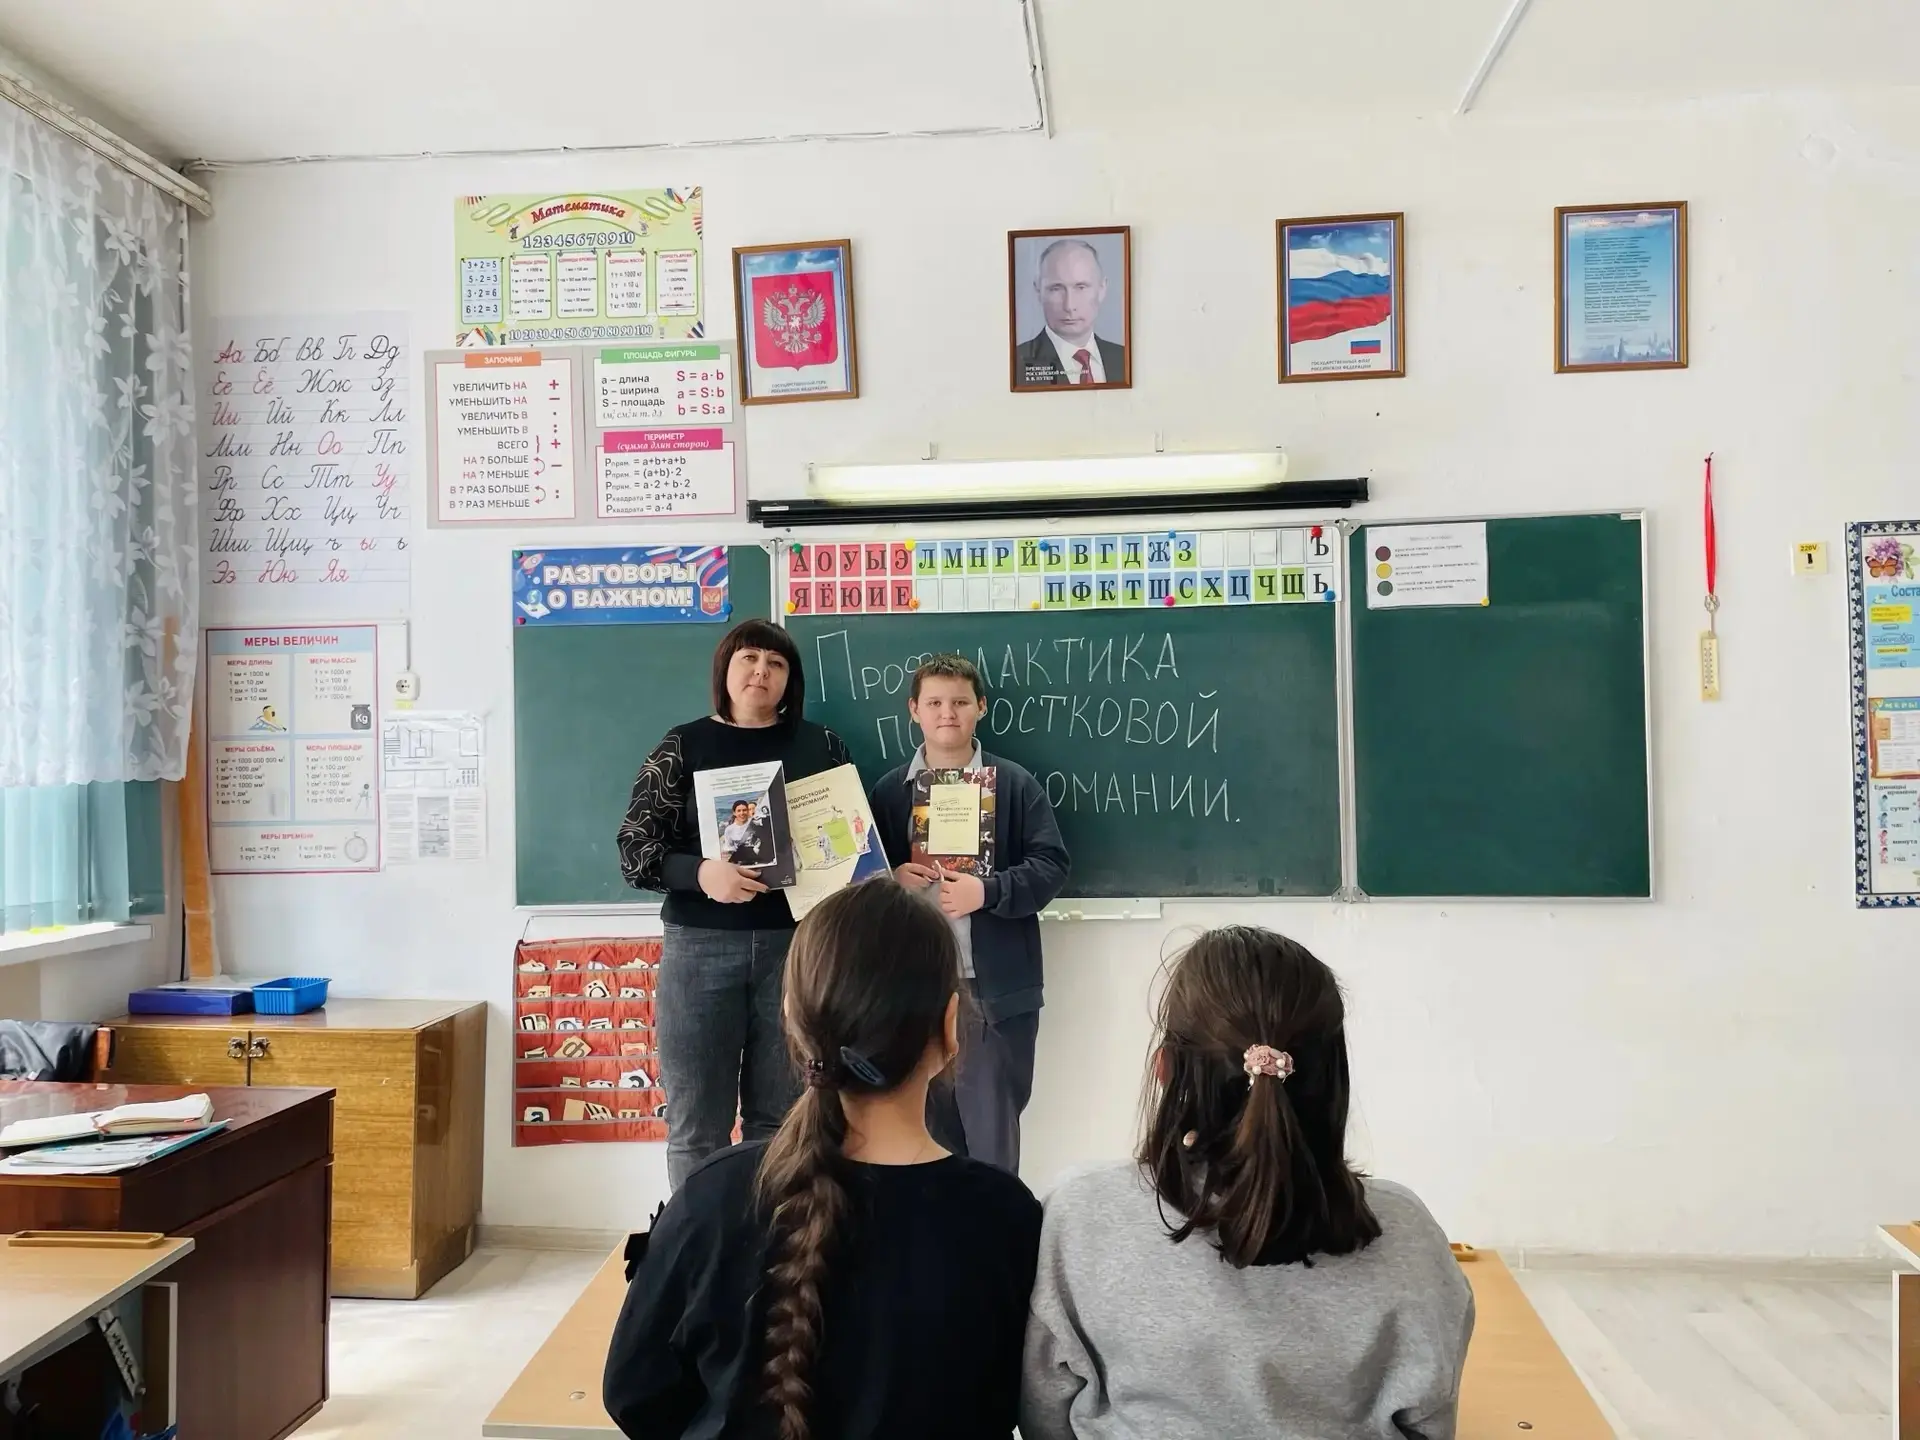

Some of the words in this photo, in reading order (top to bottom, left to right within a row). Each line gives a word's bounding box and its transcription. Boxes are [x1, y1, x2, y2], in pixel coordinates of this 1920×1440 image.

[530, 201, 626, 224] Математика
[509, 331, 521, 341] 10
[523, 330, 536, 340] 20
[537, 330, 550, 340] 30
[551, 329, 563, 339] 40
[564, 328, 577, 339] 50
[578, 328, 591, 338] 60
[593, 327, 605, 337] 70
[607, 326, 619, 337] 80
[621, 326, 633, 336] 90
[634, 325, 653, 336] 100
[214, 341, 245, 364] Аа
[254, 337, 291, 363] Бб
[296, 337, 325, 362] Вв
[333, 334, 358, 361] Гг
[363, 334, 401, 369] Дд
[624, 351, 663, 360] ПЛОЩАДЬ
[664, 350, 697, 358] ФИГУРЫ
[212, 371, 233, 396] Ее
[253, 366, 275, 396] Ёё
[296, 369, 353, 393] Жж
[371, 366, 396, 401] Зз
[619, 375, 650, 384] длина
[453, 382, 511, 392] УВЕЛИЧИТЬ
[513, 382, 527, 390] НА
[602, 387, 609, 396] b
[620, 387, 659, 396] ширина
[449, 397, 511, 407] УМЕНЬШИТЬ
[513, 396, 528, 405] НА
[602, 399, 609, 408] S
[621, 398, 665, 407] площадь
[212, 402, 241, 426] Ии
[266, 396, 296, 425] Йй
[320, 398, 351, 424] Кк
[369, 399, 406, 423] Лл
[461, 412, 519, 421] УВЕЛИЧИТЬ
[521, 411, 528, 419] В
[457, 426, 520, 436] УМЕНЬШИТЬ
[522, 426, 528, 434] В
[644, 433, 685, 441] ПЕРИМЕТР
[206, 433, 253, 458] Мм
[269, 431, 303, 456] Нн
[318, 431, 344, 455] Оо
[367, 428, 406, 455] Пп
[498, 441, 529, 450] ВСЕГО
[617, 443, 649, 451] (сумма
[673, 440, 710, 450] сторон)
[464, 457, 478, 465] НА
[480, 456, 485, 464] ?
[487, 455, 529, 464] БОЛЬШЕ
[480, 471, 485, 479] ?
[487, 470, 530, 479] МЕНЬШЕ
[209, 465, 238, 500] Рр
[261, 465, 285, 490] Сс
[304, 464, 354, 489] Тт
[371, 463, 397, 497] Уу
[450, 486, 456, 494] В
[459, 486, 464, 494] ?
[467, 485, 486, 494] РАЗ
[488, 485, 530, 493] БОЛЬШЕ
[449, 501, 456, 509] В
[466, 500, 485, 508] РАЗ
[487, 499, 530, 508] МЕНЬШЕ
[213, 499, 246, 532] Фф
[261, 496, 302, 522] Хх
[323, 495, 359, 526] Цц
[375, 494, 402, 520] Чч
[209, 527, 252, 553] Шш
[265, 527, 314, 558] Щщ
[325, 538, 342, 551] ъ
[360, 537, 377, 551] ы
[397, 537, 409, 551] ь
[793, 548, 809, 572] А
[818, 551, 832, 572] О
[842, 550, 859, 571] У
[865, 550, 887, 570] Ы
[895, 550, 908, 570] Э
[919, 549, 936, 569] Л
[944, 548, 964, 569] М
[970, 547, 987, 568] Н
[995, 547, 1010, 567] Р
[1021, 541, 1039, 566] Й
[1047, 545, 1061, 566] Б
[1073, 544, 1089, 565] В
[1100, 543, 1116, 564] Г
[1124, 542, 1142, 569] Д
[1148, 542, 1171, 563] Ж
[1178, 540, 1193, 562] З
[212, 560, 237, 584] Ээ
[258, 559, 299, 584] Юю
[319, 558, 350, 583] Яя
[543, 563, 697, 585] РАЗГОВОРЫ
[547, 588, 567, 608] О
[572, 587, 694, 609] ВАЖНОМ!
[794, 588, 809, 609] Я
[820, 584, 834, 608] Ё
[840, 588, 862, 608] Ю
[866, 587, 885, 607] И
[895, 586, 910, 606] Е
[1048, 582, 1065, 603] П
[1071, 580, 1092, 602] Ф
[1100, 580, 1116, 601] К
[1126, 580, 1141, 600] Т
[1149, 578, 1171, 600] Ш
[1179, 578, 1194, 599] С
[1204, 577, 1222, 598] Х
[1230, 576, 1250, 601] Ц
[1258, 575, 1275, 597] Ч
[1282, 574, 1305, 598] Щ
[1313, 574, 1329, 594] Ь
[244, 637, 280, 647] МЕРЫ
[283, 636, 339, 646] ВЕЛИЧИН
[816, 630, 1180, 702] ПРОФЛАКТИКА
[355, 714, 368, 724] Kg
[876, 690, 1221, 760] ПООСТКОВОЙ
[1033, 771, 1241, 823] ОМАНИИ.
